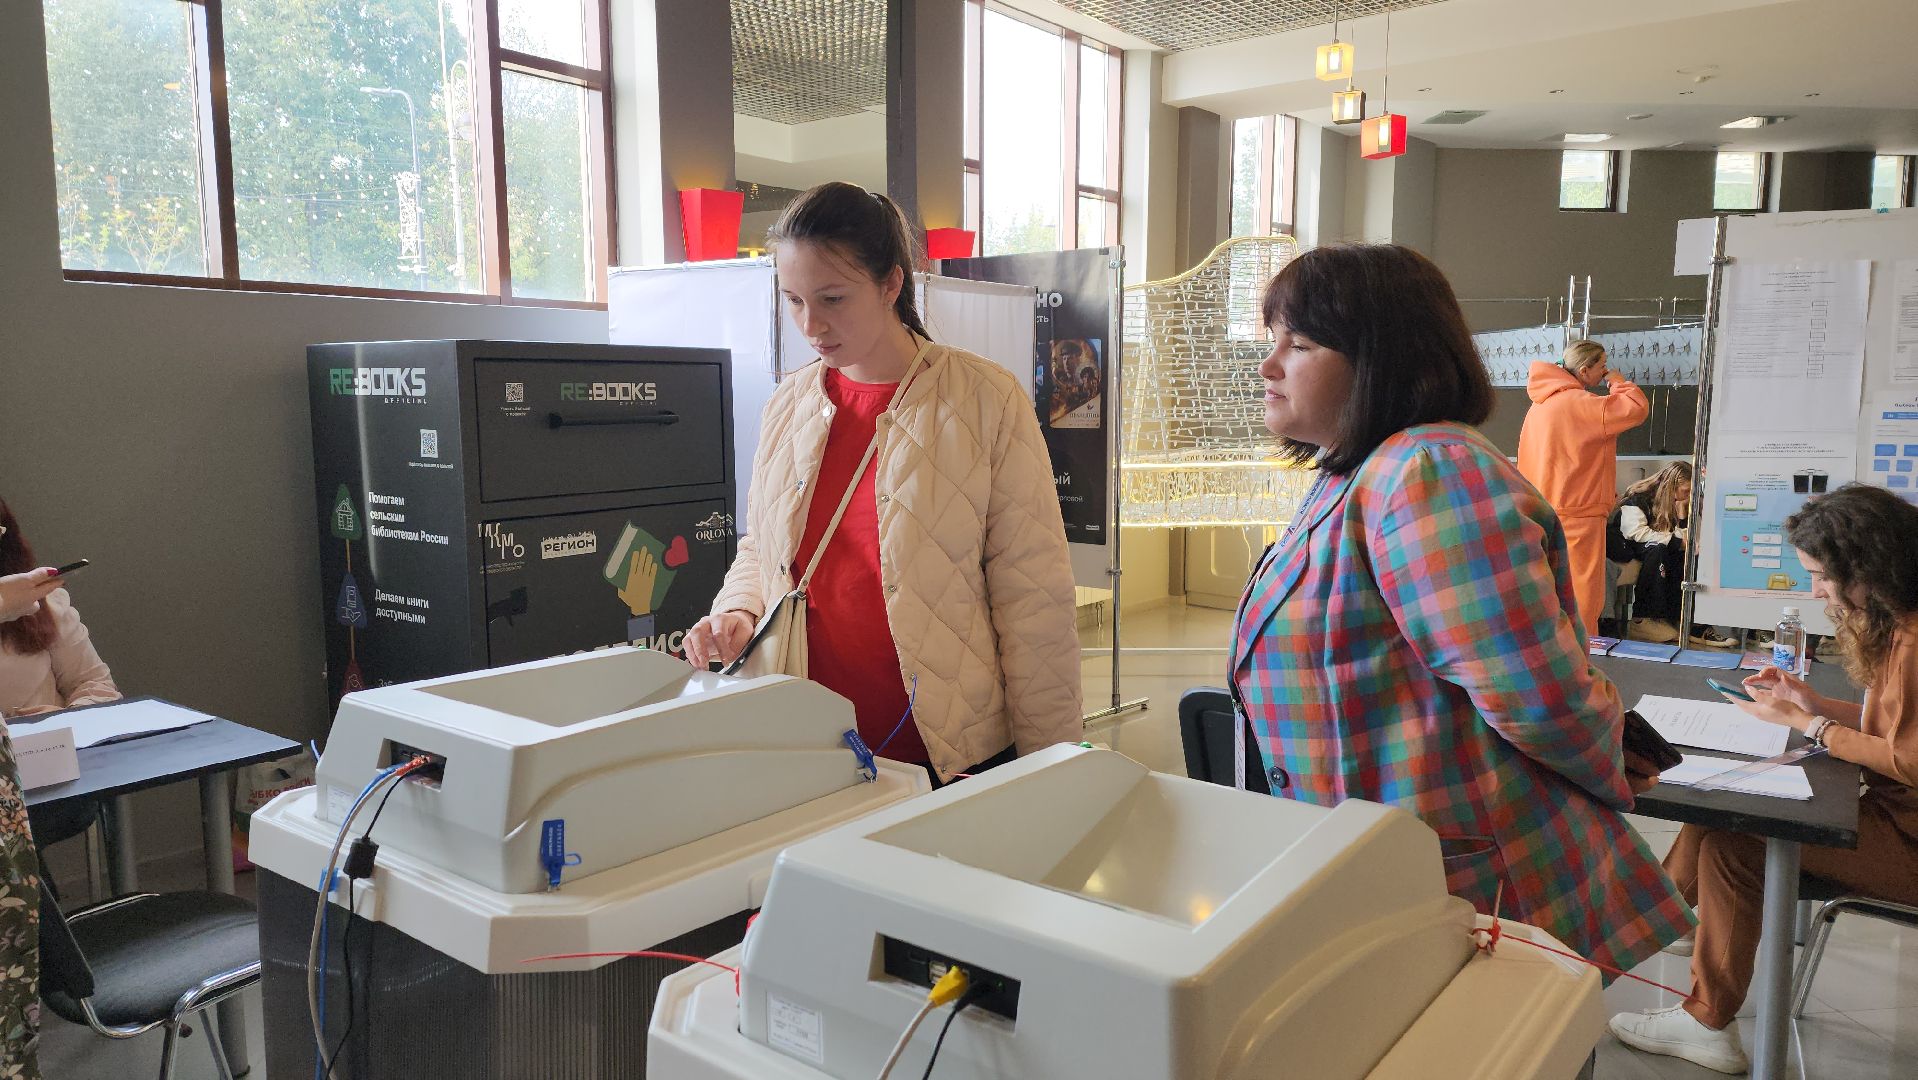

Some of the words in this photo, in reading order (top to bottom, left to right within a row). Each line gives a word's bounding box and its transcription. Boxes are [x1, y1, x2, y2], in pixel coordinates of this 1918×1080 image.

[1037, 292, 1063, 308] НО
[330, 367, 427, 396] RE:BOOKS
[560, 382, 657, 401] RE:BOOKS
[368, 492, 405, 506] Помогаем
[370, 510, 405, 523] сельским
[371, 525, 420, 541] библиотекам
[420, 530, 449, 545] России
[695, 528, 733, 541] ORLOVA
[544, 539, 595, 553] РЕГИОН
[375, 588, 405, 605] Делаем
[406, 596, 430, 609] книги
[375, 607, 426, 625] доступными
